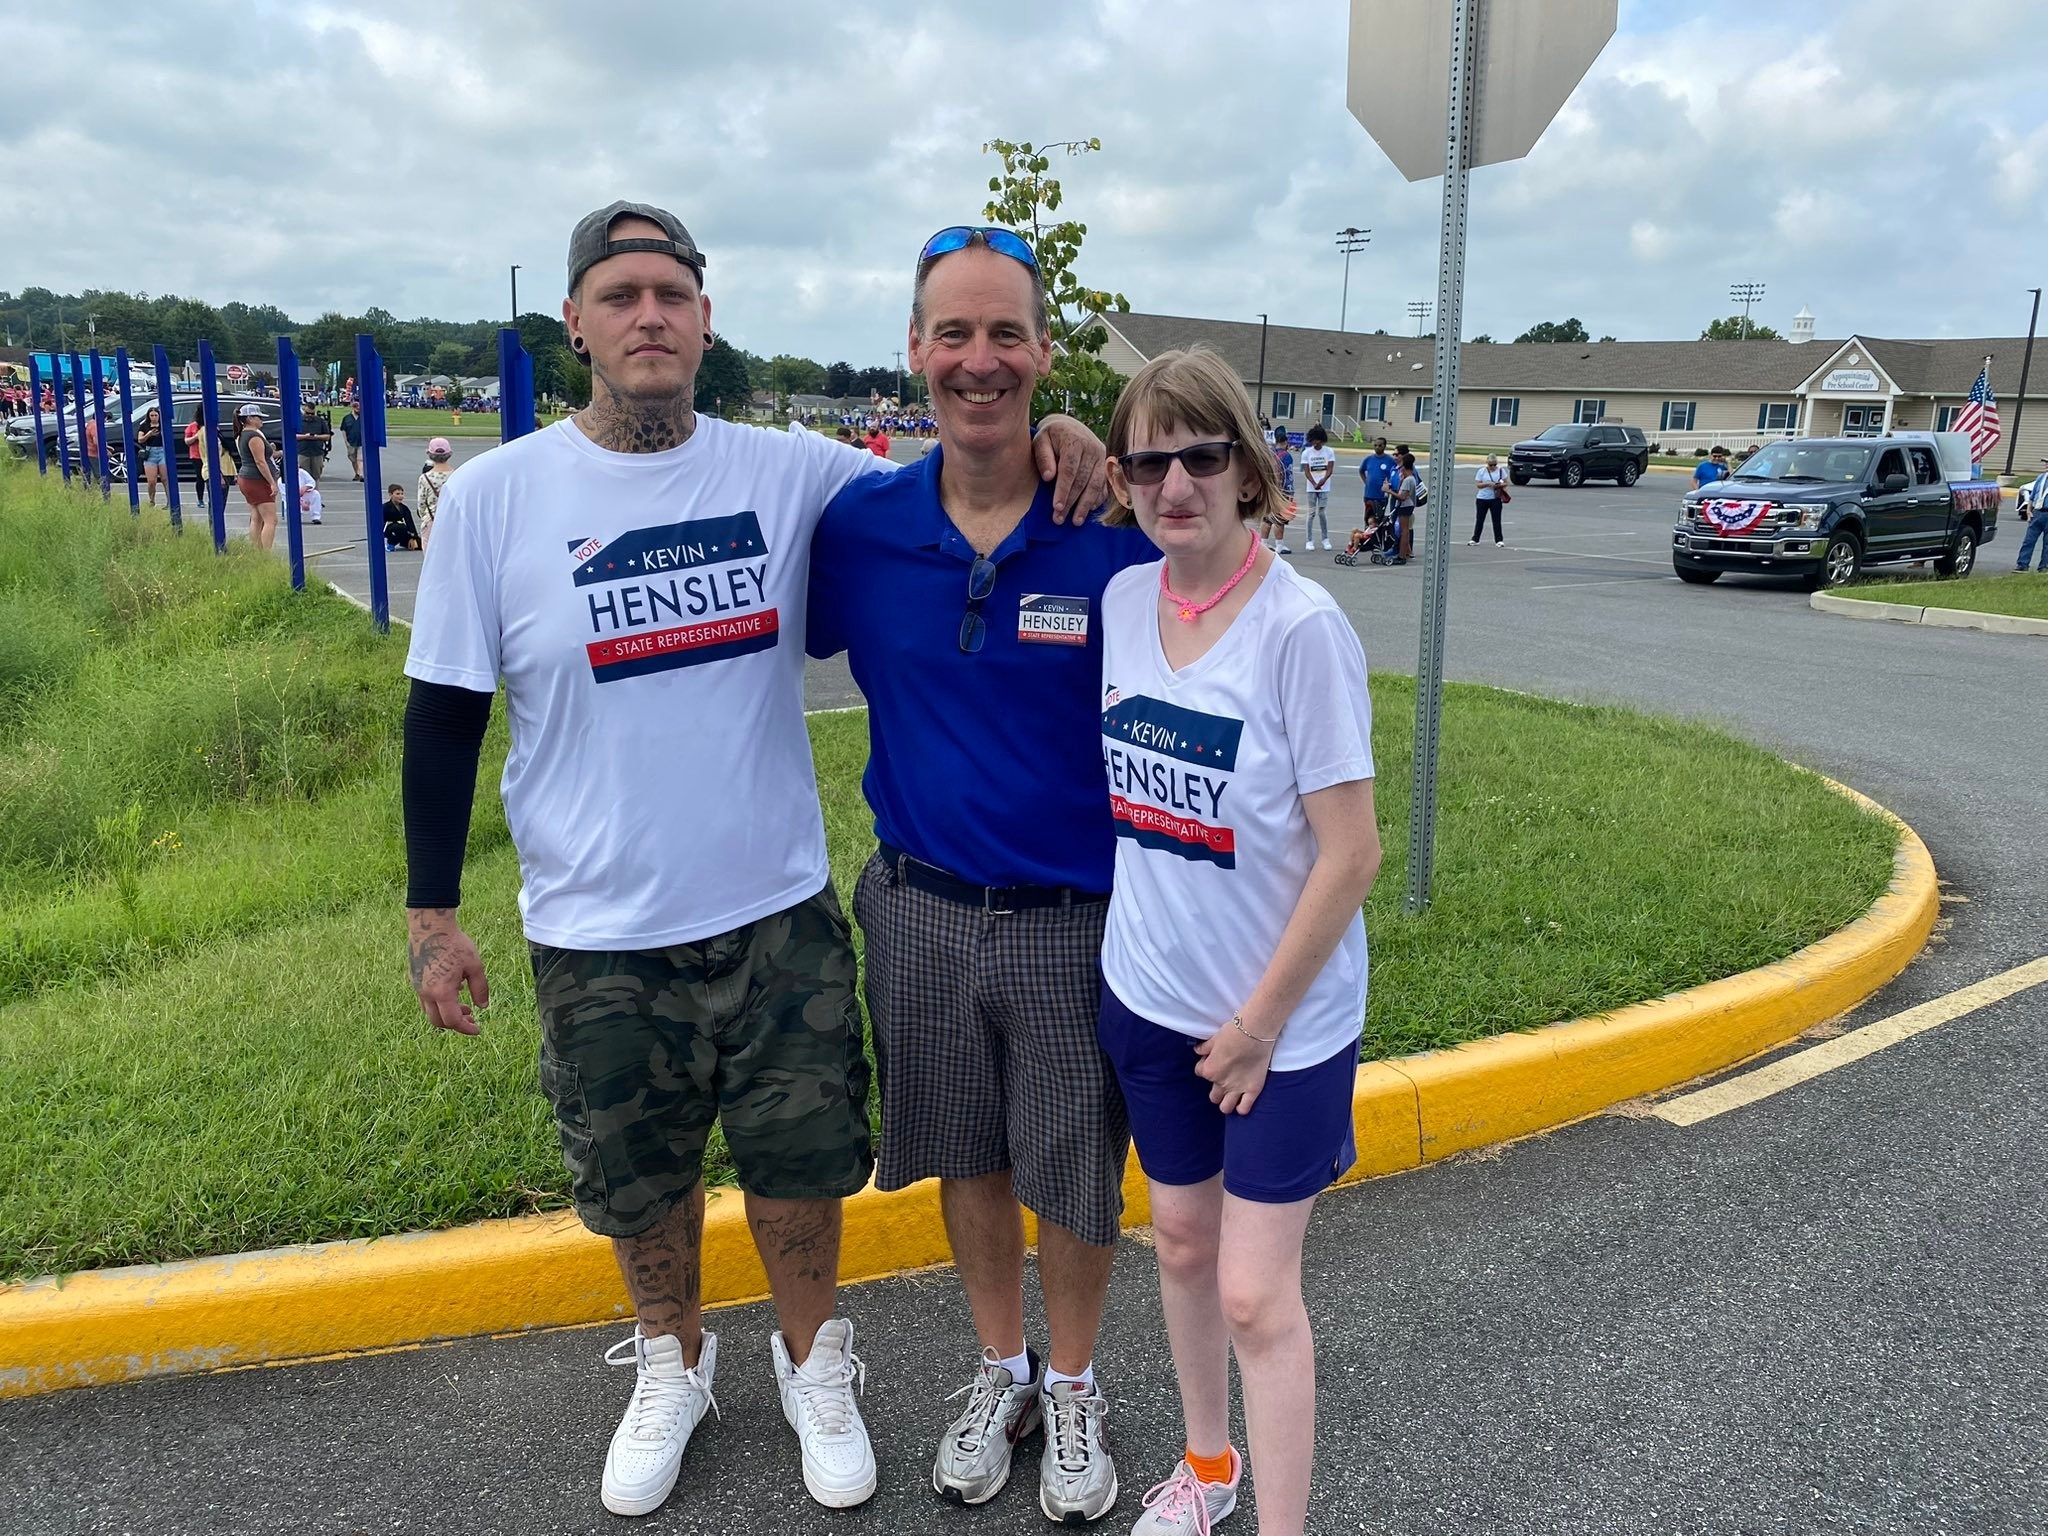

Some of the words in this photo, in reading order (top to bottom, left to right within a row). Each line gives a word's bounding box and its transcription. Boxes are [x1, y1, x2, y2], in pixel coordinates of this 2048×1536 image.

[1837, 381, 1855, 389] School
[1856, 381, 1874, 389] Center
[575, 538, 602, 562] VOTE
[642, 542, 705, 570] KEVIN
[588, 563, 767, 633] HENSLEY
[1043, 604, 1064, 612] KEVIN
[1023, 615, 1084, 631] HENSLEY
[615, 637, 653, 656] STATE
[657, 618, 761, 648] REPRESENTATIVE
[1130, 719, 1177, 751] KEVIN
[1110, 799, 1129, 815] TAT
[1127, 807, 1210, 842] REPRESENTATIVE
[1071, 1382, 1085, 1391] NIKE
